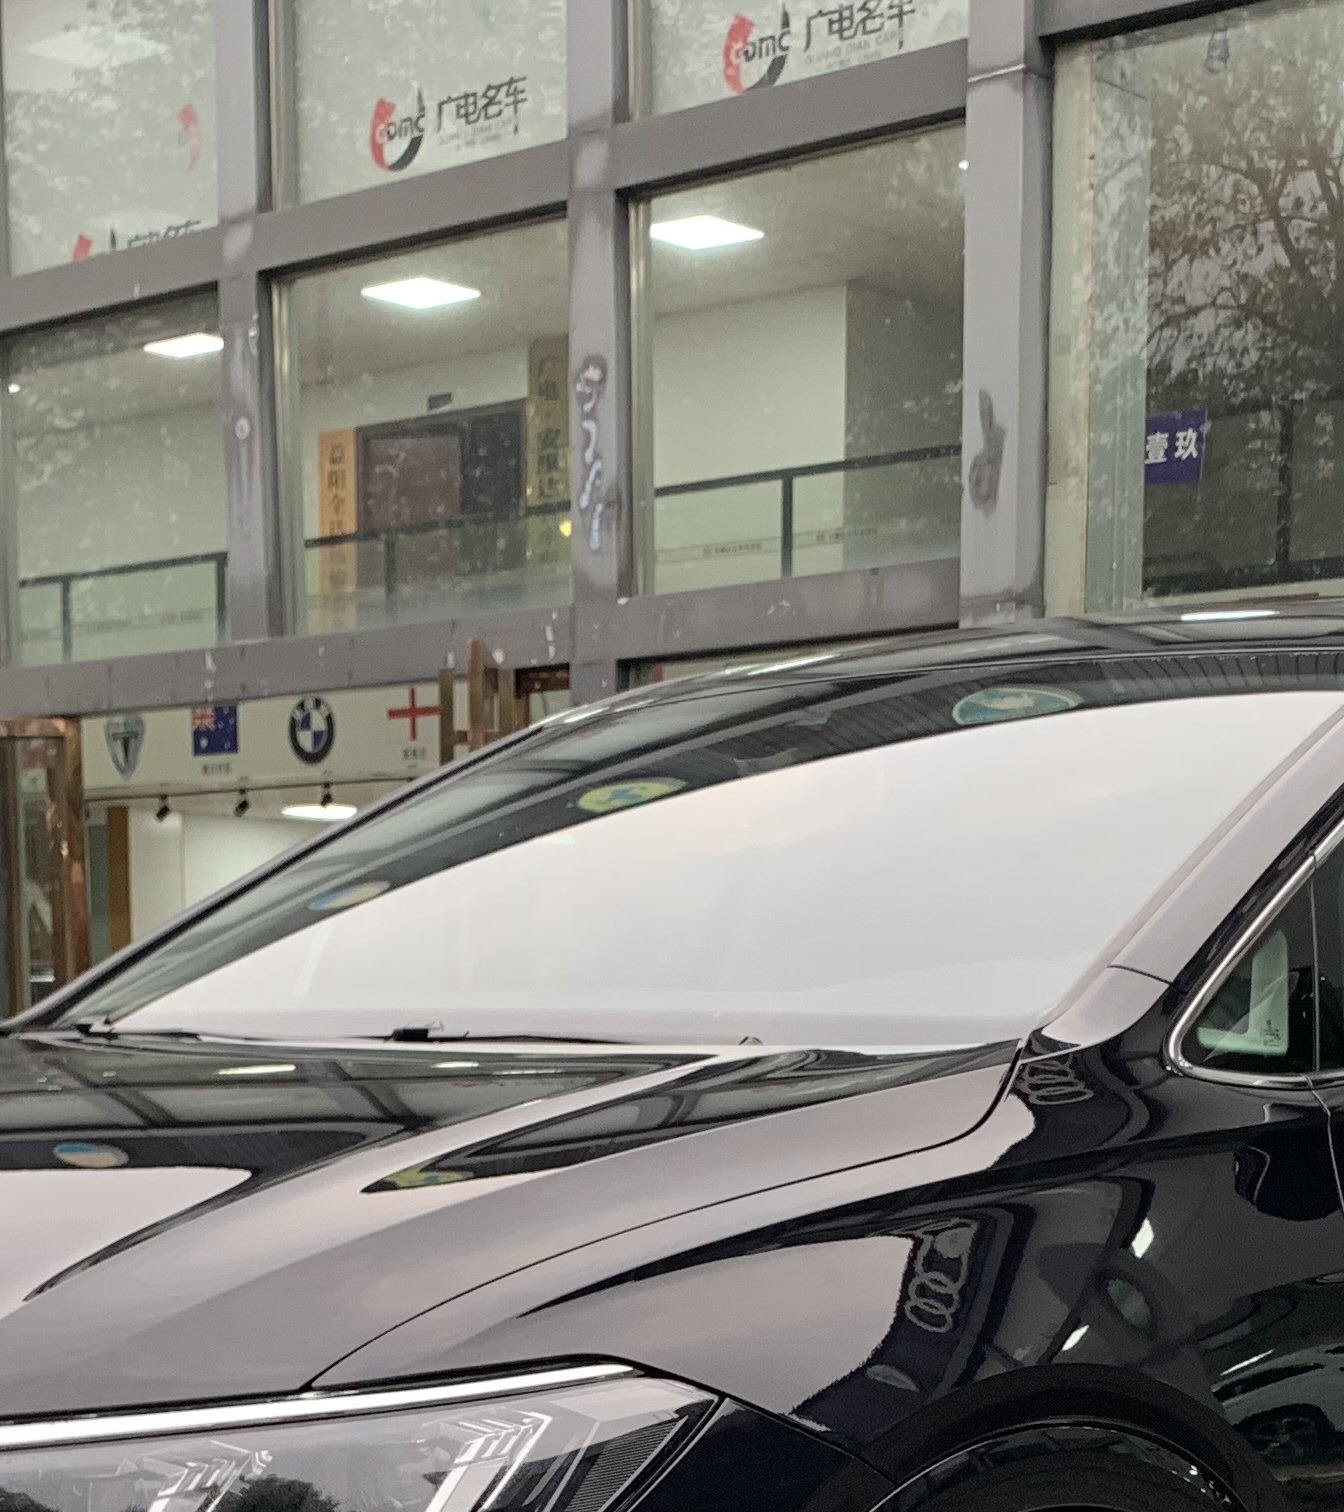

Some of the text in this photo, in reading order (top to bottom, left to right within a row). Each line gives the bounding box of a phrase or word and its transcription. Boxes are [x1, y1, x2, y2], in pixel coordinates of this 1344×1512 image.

[805, 0, 915, 51] 广电名车
[436, 76, 528, 134] 广电名车
[1145, 426, 1199, 465] 壹玖
